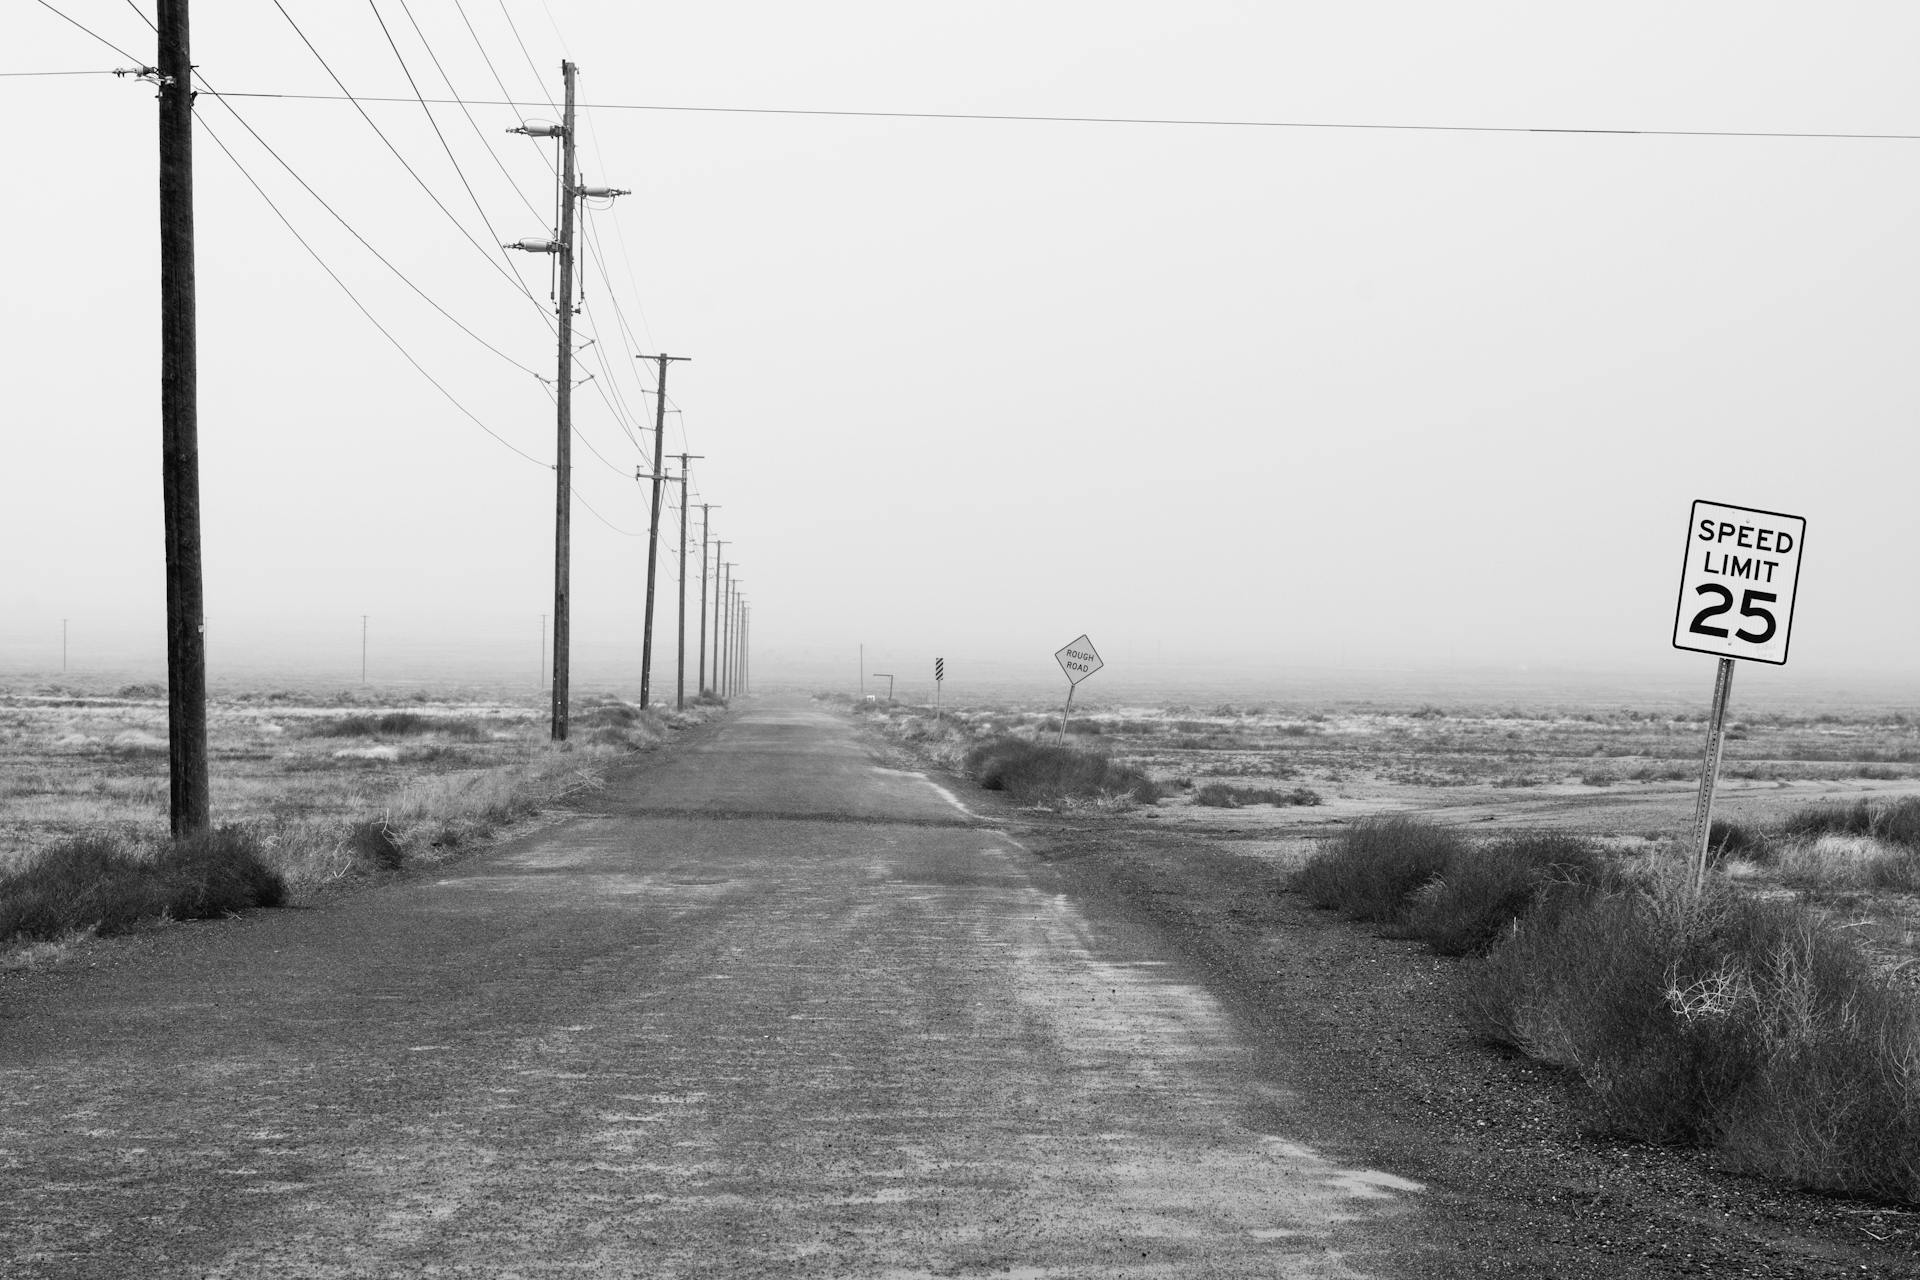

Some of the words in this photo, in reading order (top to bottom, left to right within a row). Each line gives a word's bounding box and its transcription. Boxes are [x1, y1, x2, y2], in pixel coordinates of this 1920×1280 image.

[1698, 519, 1793, 554] SPEED
[1704, 551, 1779, 583] LIMIT
[1689, 583, 1777, 644] 25
[1066, 649, 1095, 662] ROUGH
[1066, 661, 1089, 673] ROAD
